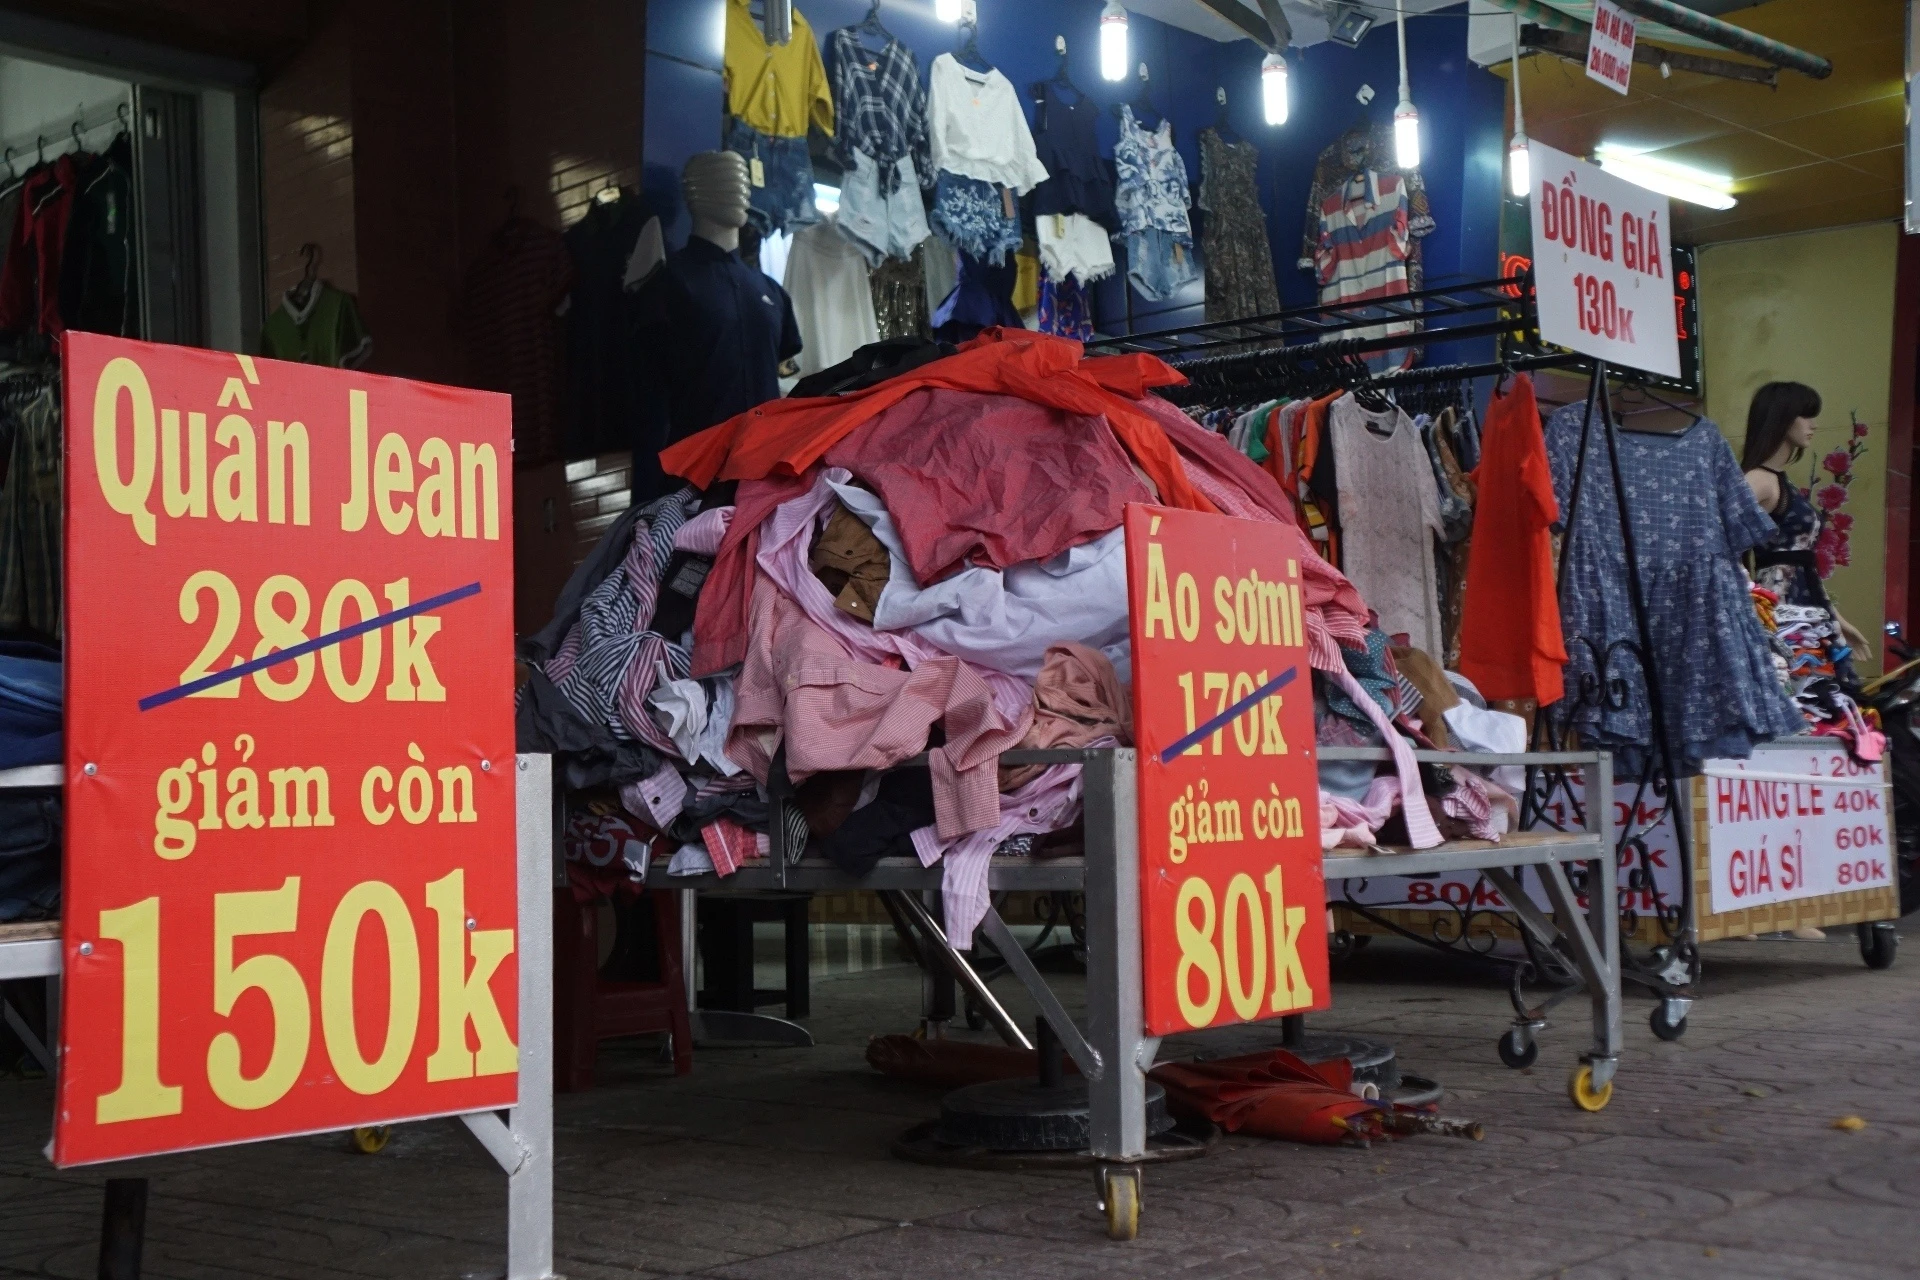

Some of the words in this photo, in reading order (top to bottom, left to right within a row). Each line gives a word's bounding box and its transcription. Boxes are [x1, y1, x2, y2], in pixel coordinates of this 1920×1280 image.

[1541, 171, 1613, 262] ĐỒNG
[1622, 211, 1664, 278] GIÁ
[93, 354, 310, 546] Quần
[341, 390, 500, 541] Jean
[1145, 516, 1201, 643] Áo
[178, 570, 447, 704] 280k
[1178, 668, 1289, 756] 170k
[154, 732, 335, 860] giảm
[361, 740, 477, 825] còn
[1169, 779, 1243, 864] giảm
[1253, 782, 1303, 840] còn
[1717, 764, 1790, 824] HÀNG
[1834, 789, 1880, 813] 40k
[1836, 825, 1884, 850] 60k
[1408, 882, 1506, 907] 80k
[1729, 834, 1773, 898] GIÁ
[1838, 859, 1886, 885] 80k
[1175, 864, 1313, 1029] 80k
[96, 869, 519, 1125] 150k
